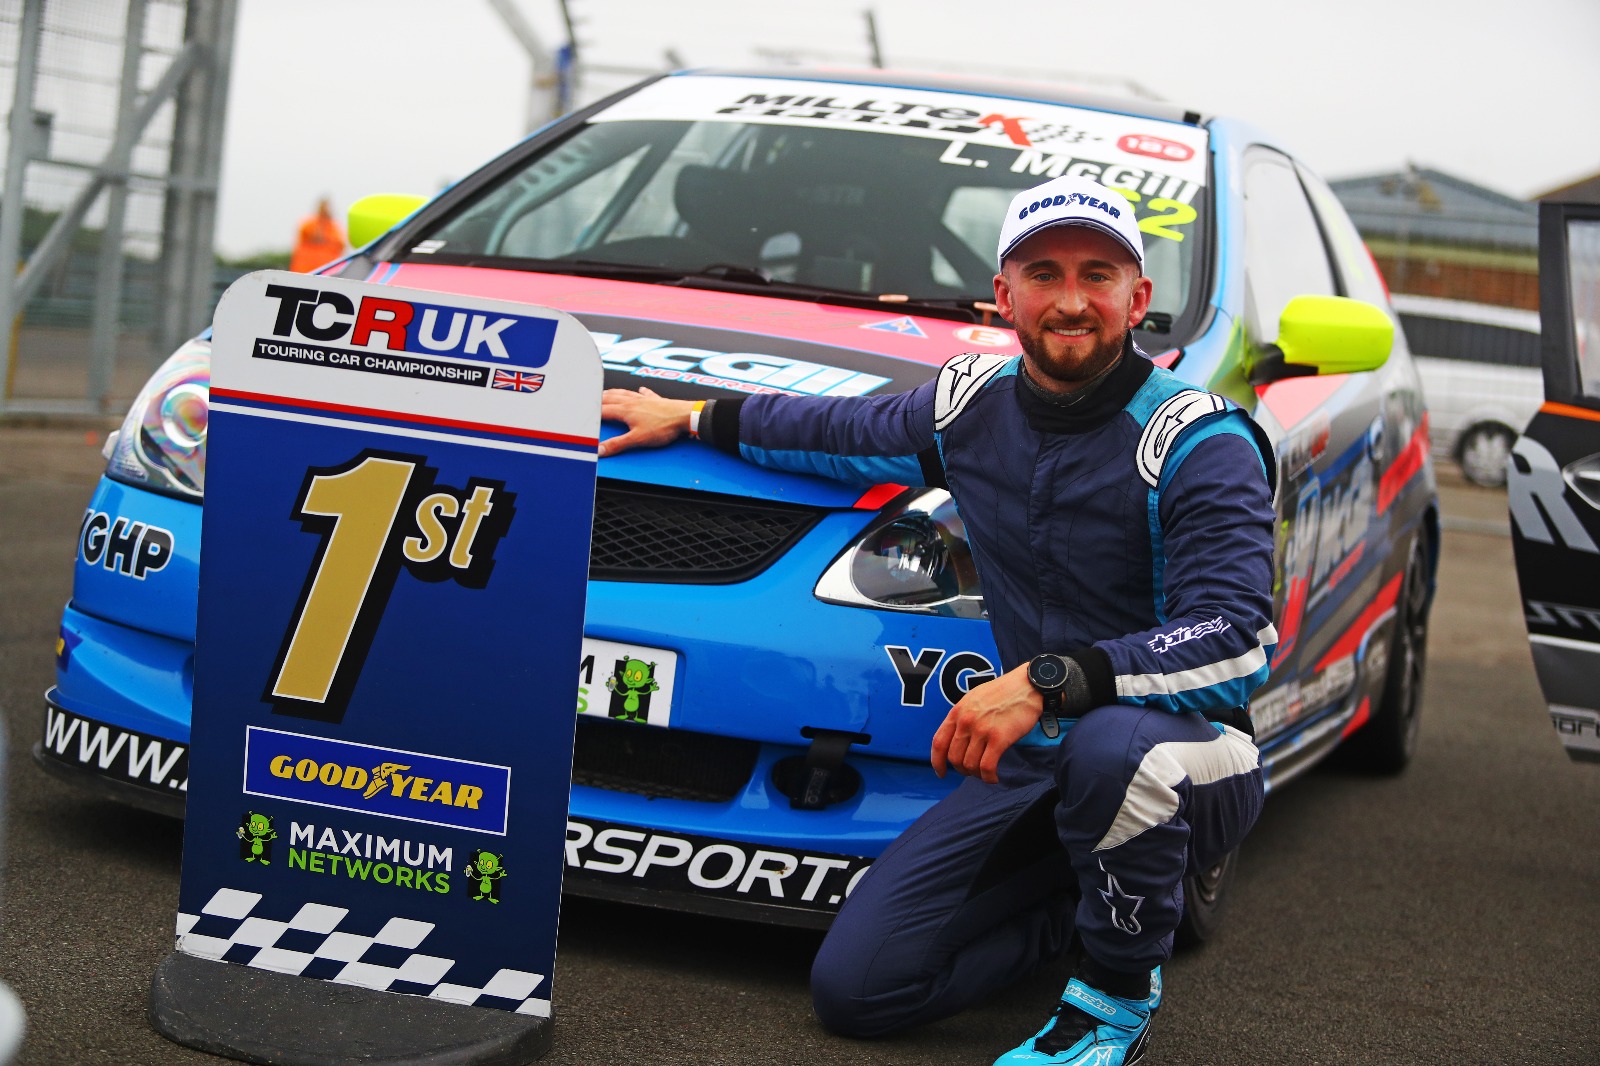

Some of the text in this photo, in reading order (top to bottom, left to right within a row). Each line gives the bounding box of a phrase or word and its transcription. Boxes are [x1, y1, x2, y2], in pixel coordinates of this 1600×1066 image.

[258, 342, 483, 382] TOURING CAR CHAMPIONSHIP
[265, 452, 505, 713] 1st
[885, 644, 999, 706] YG
[45, 707, 189, 791] WWW.
[288, 847, 451, 894] NETWORKS
[289, 821, 453, 872] MAXIMUM
[564, 821, 874, 905] RSPORT.
